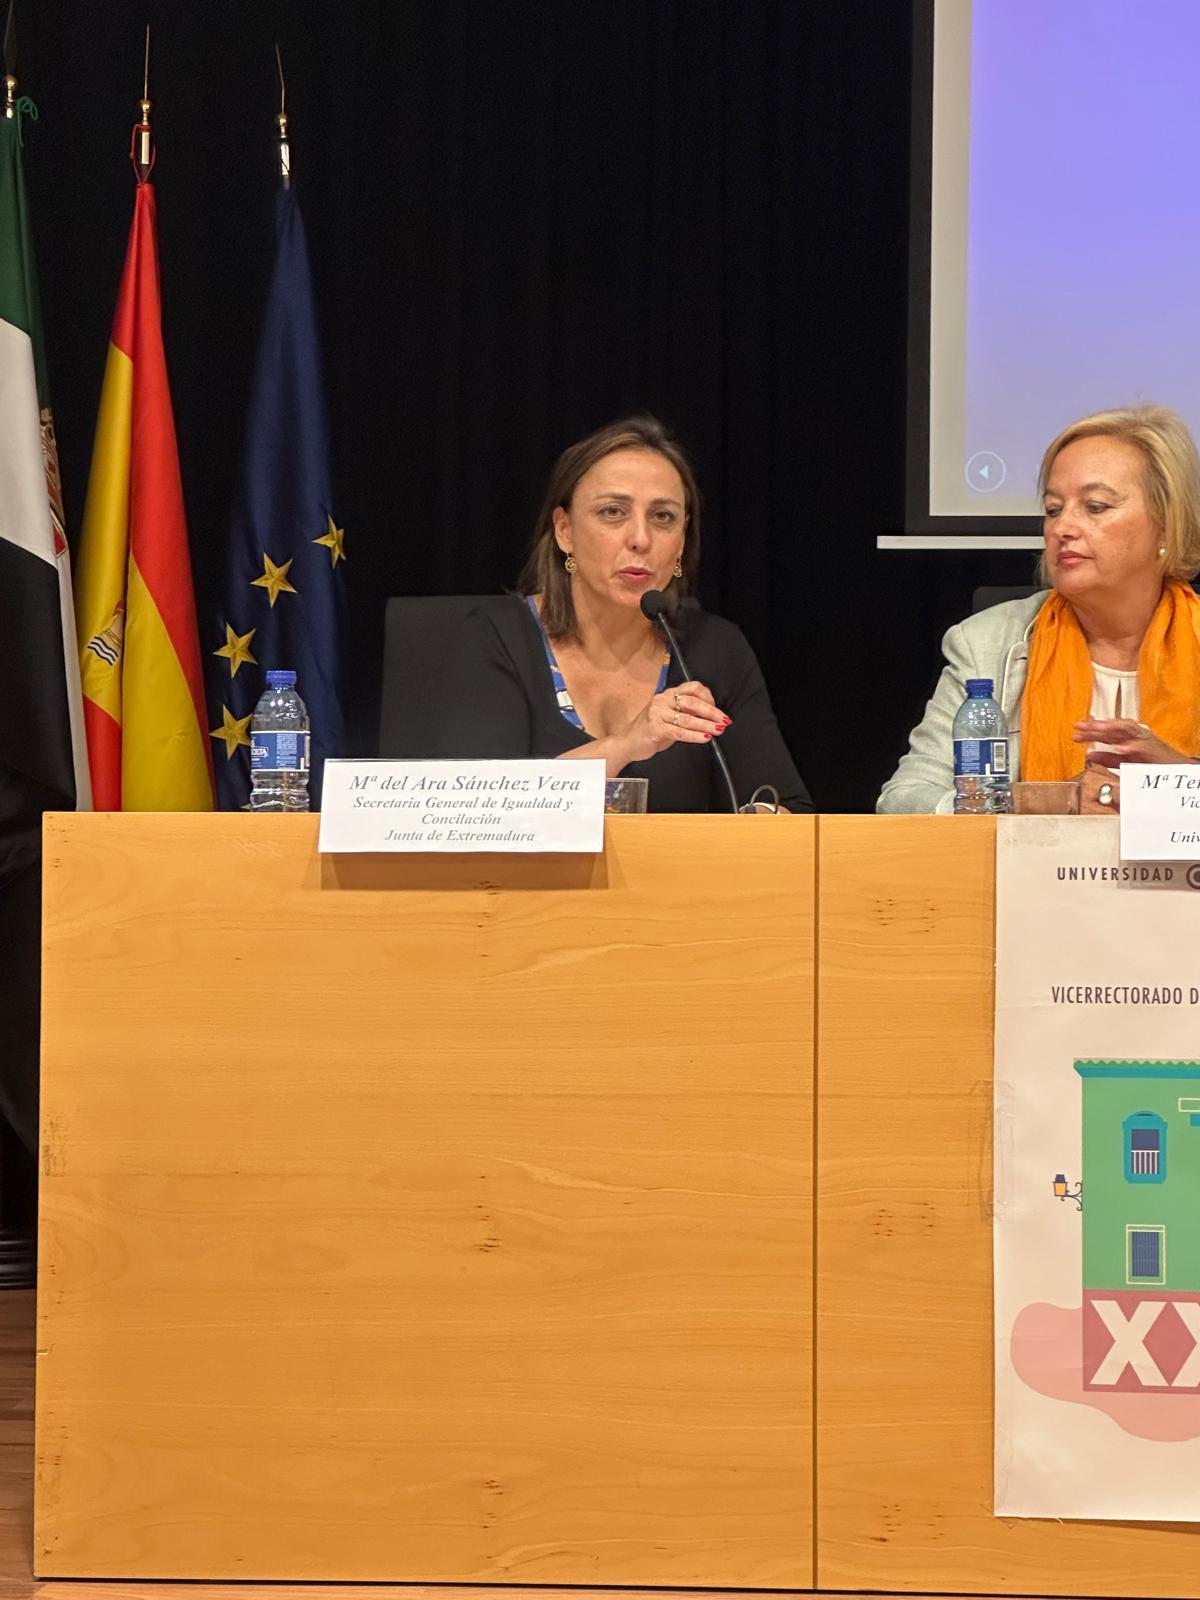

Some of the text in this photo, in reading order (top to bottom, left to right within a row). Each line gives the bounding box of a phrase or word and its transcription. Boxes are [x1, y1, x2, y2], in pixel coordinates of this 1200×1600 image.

[380, 775, 409, 791] del
[410, 775, 447, 791] Ara
[451, 775, 530, 792] Sánchez
[537, 776, 581, 791] Vera
[353, 796, 573, 812] Secretaria General de Igualdad y
[421, 813, 501, 825] Concilación
[384, 829, 536, 842] Junta de Extremadura
[1057, 867, 1173, 881] UNIVERSIDAD
[1051, 986, 1183, 1004] VICERRECTORADO
